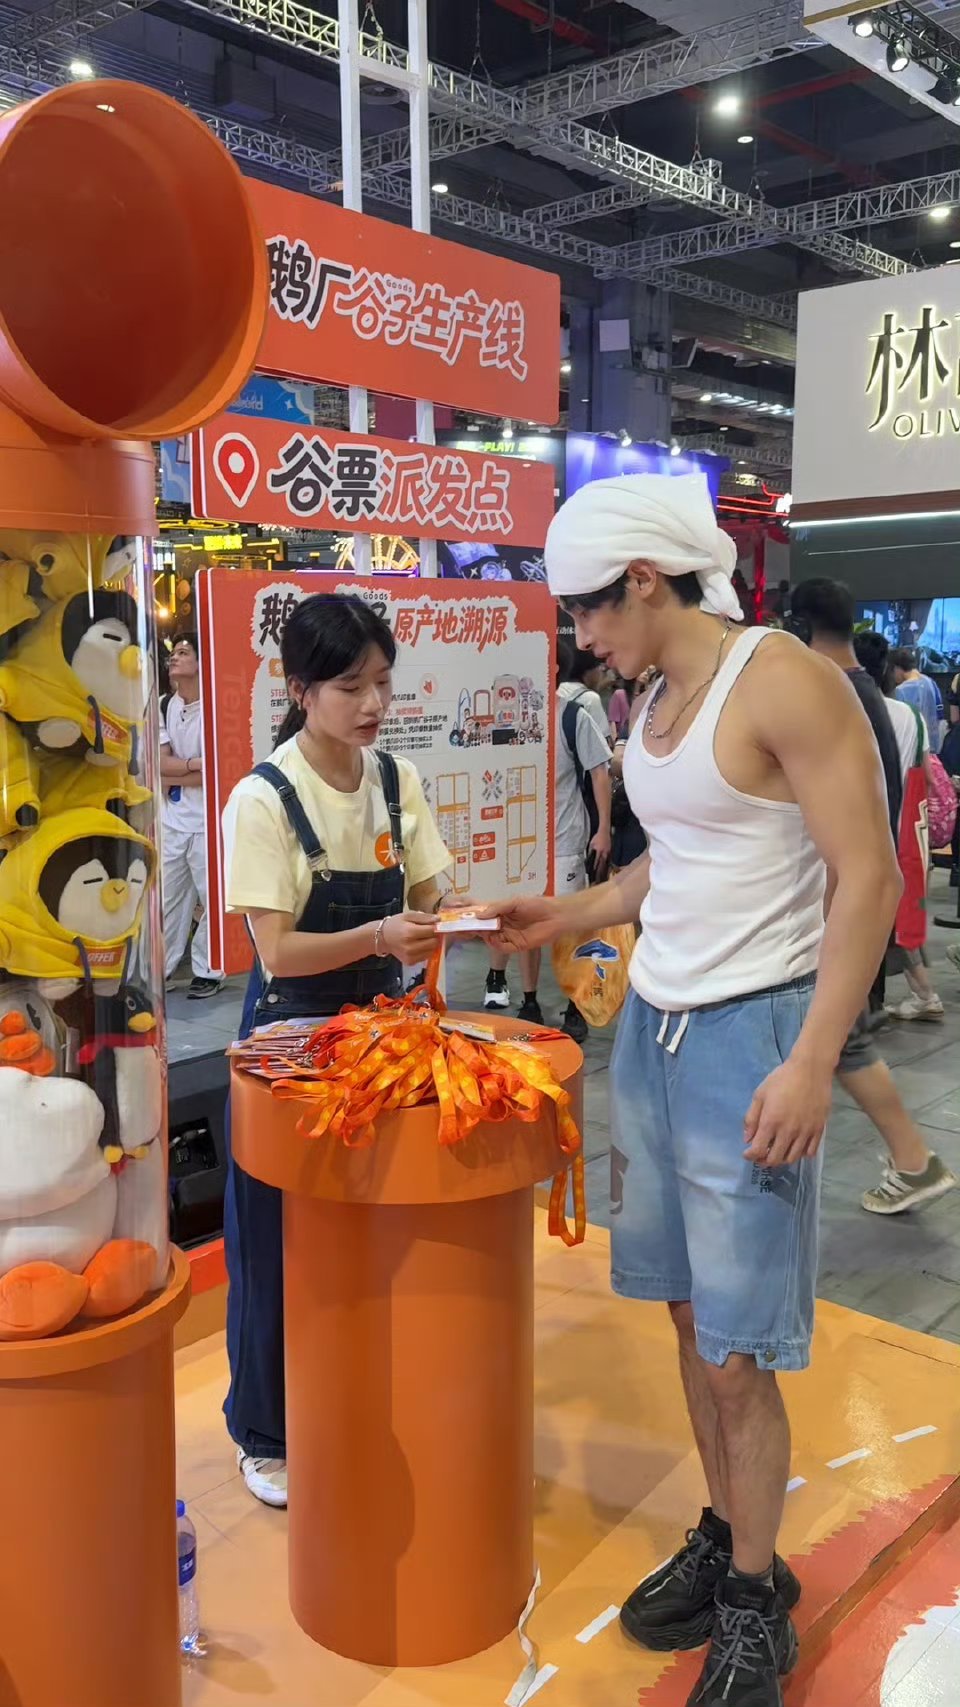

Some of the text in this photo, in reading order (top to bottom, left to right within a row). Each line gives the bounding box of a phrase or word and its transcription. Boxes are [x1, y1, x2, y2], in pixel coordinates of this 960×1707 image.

[385, 277, 413, 294] Goods
[865, 307, 960, 430] 林
[270, 438, 511, 532] 谷票派发点
[363, 589, 389, 601] Goods
